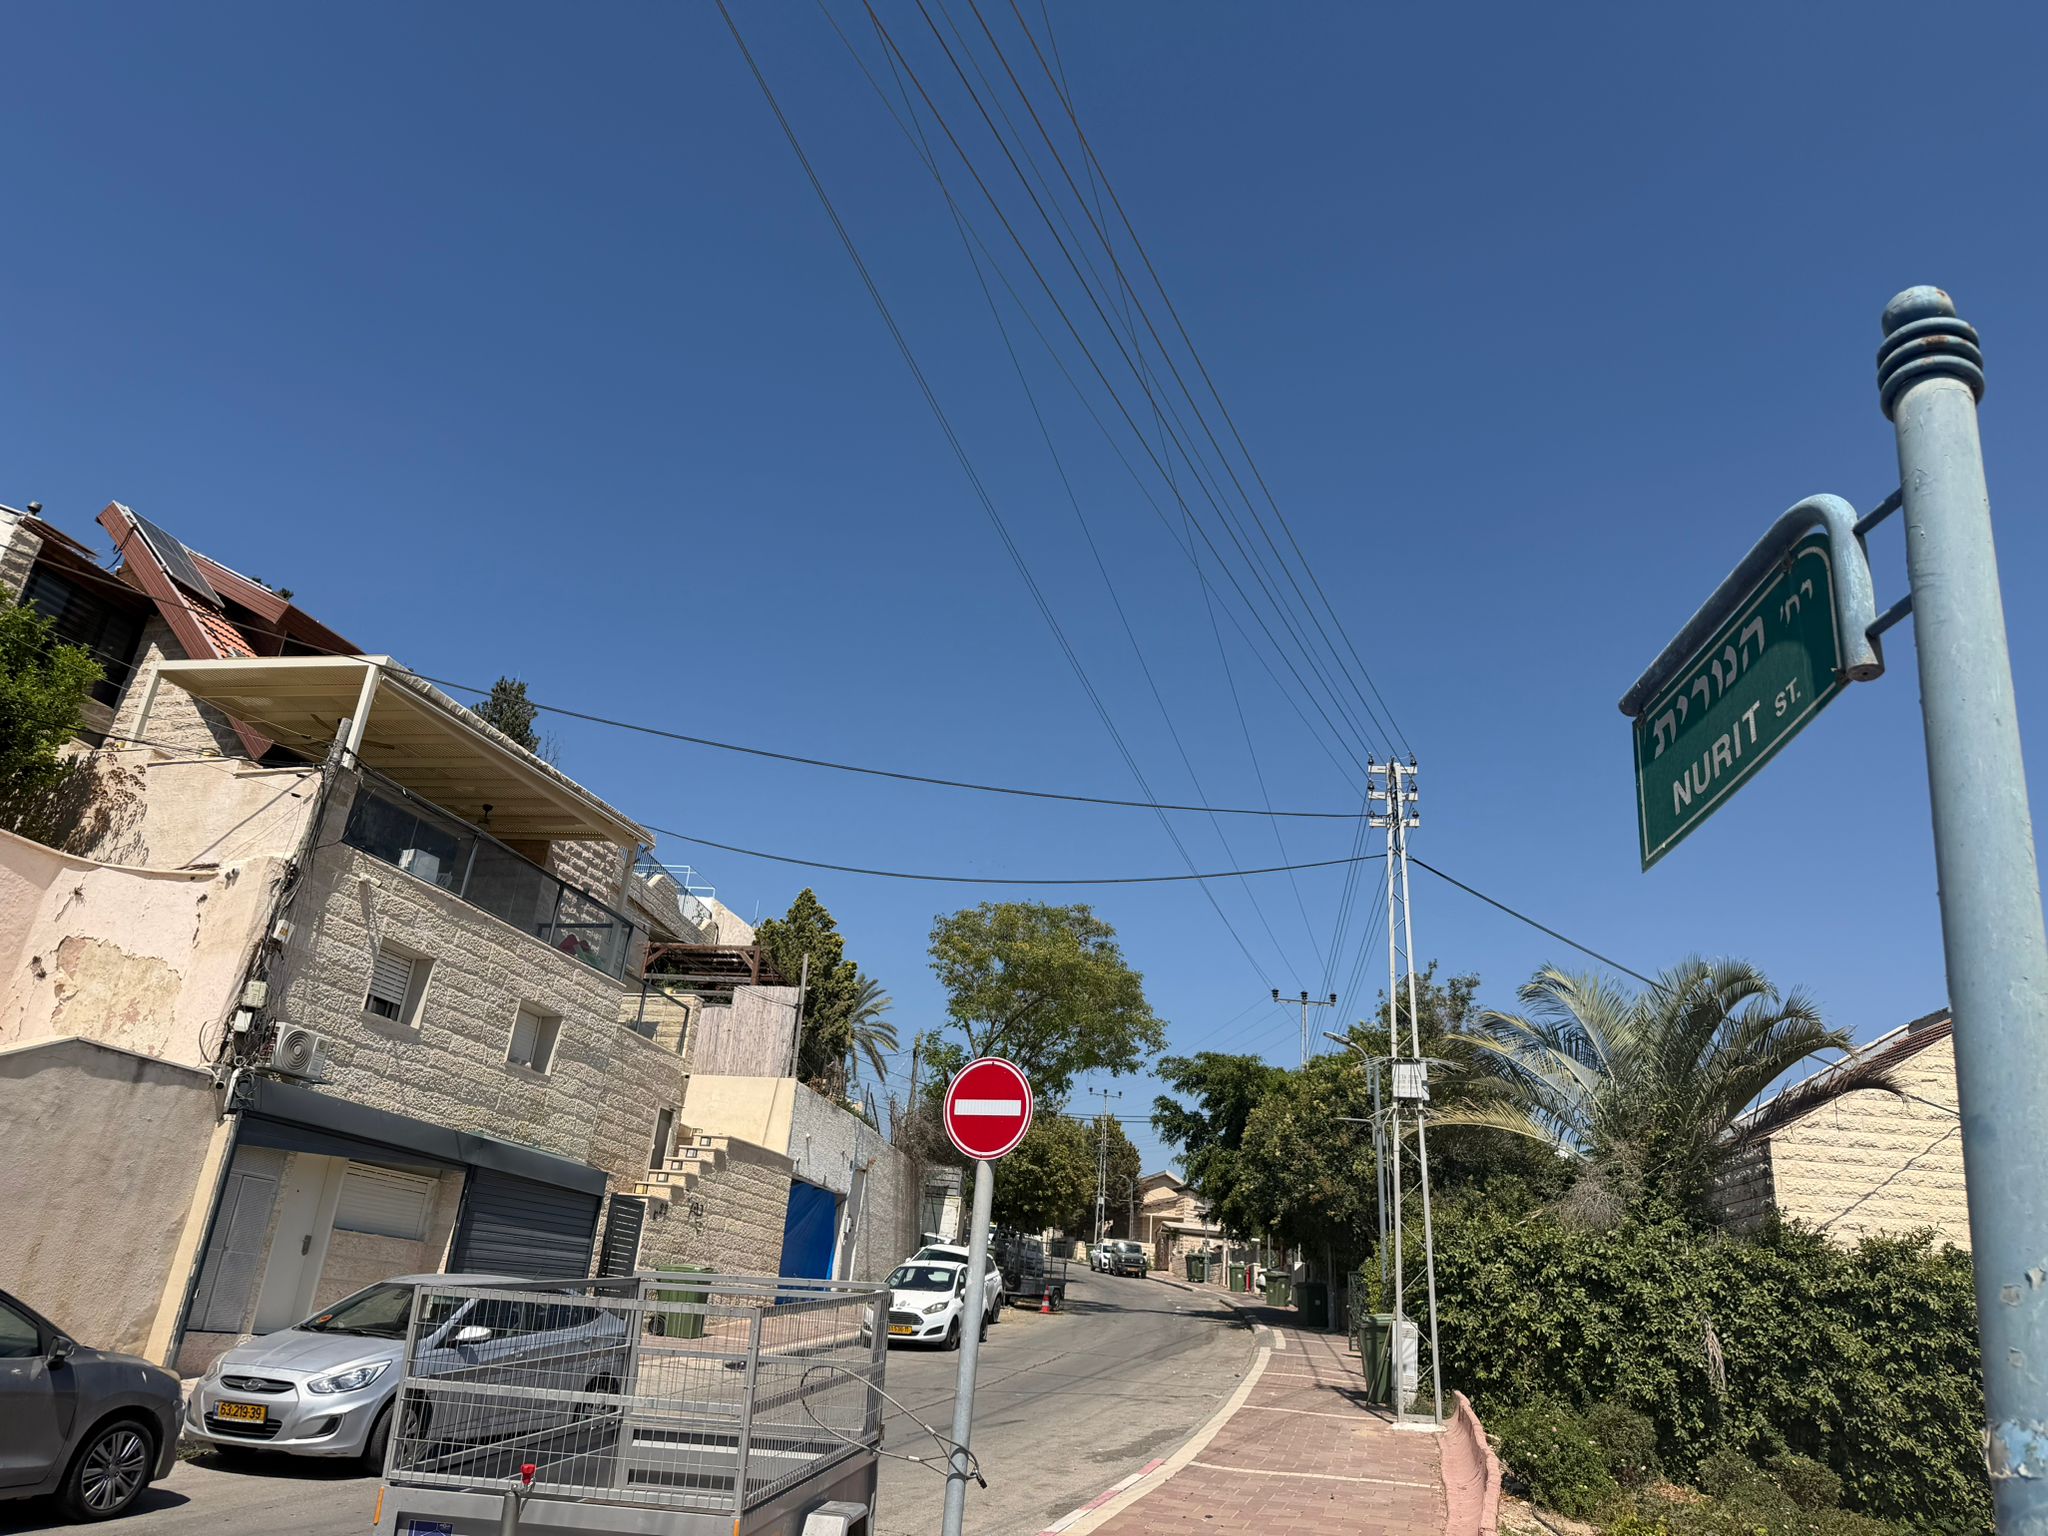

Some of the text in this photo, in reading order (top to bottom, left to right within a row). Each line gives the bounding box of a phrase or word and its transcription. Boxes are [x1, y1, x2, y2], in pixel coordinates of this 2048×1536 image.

[1653, 616, 1765, 759] הנורית
[1673, 677, 1801, 816] NURIT ST.
